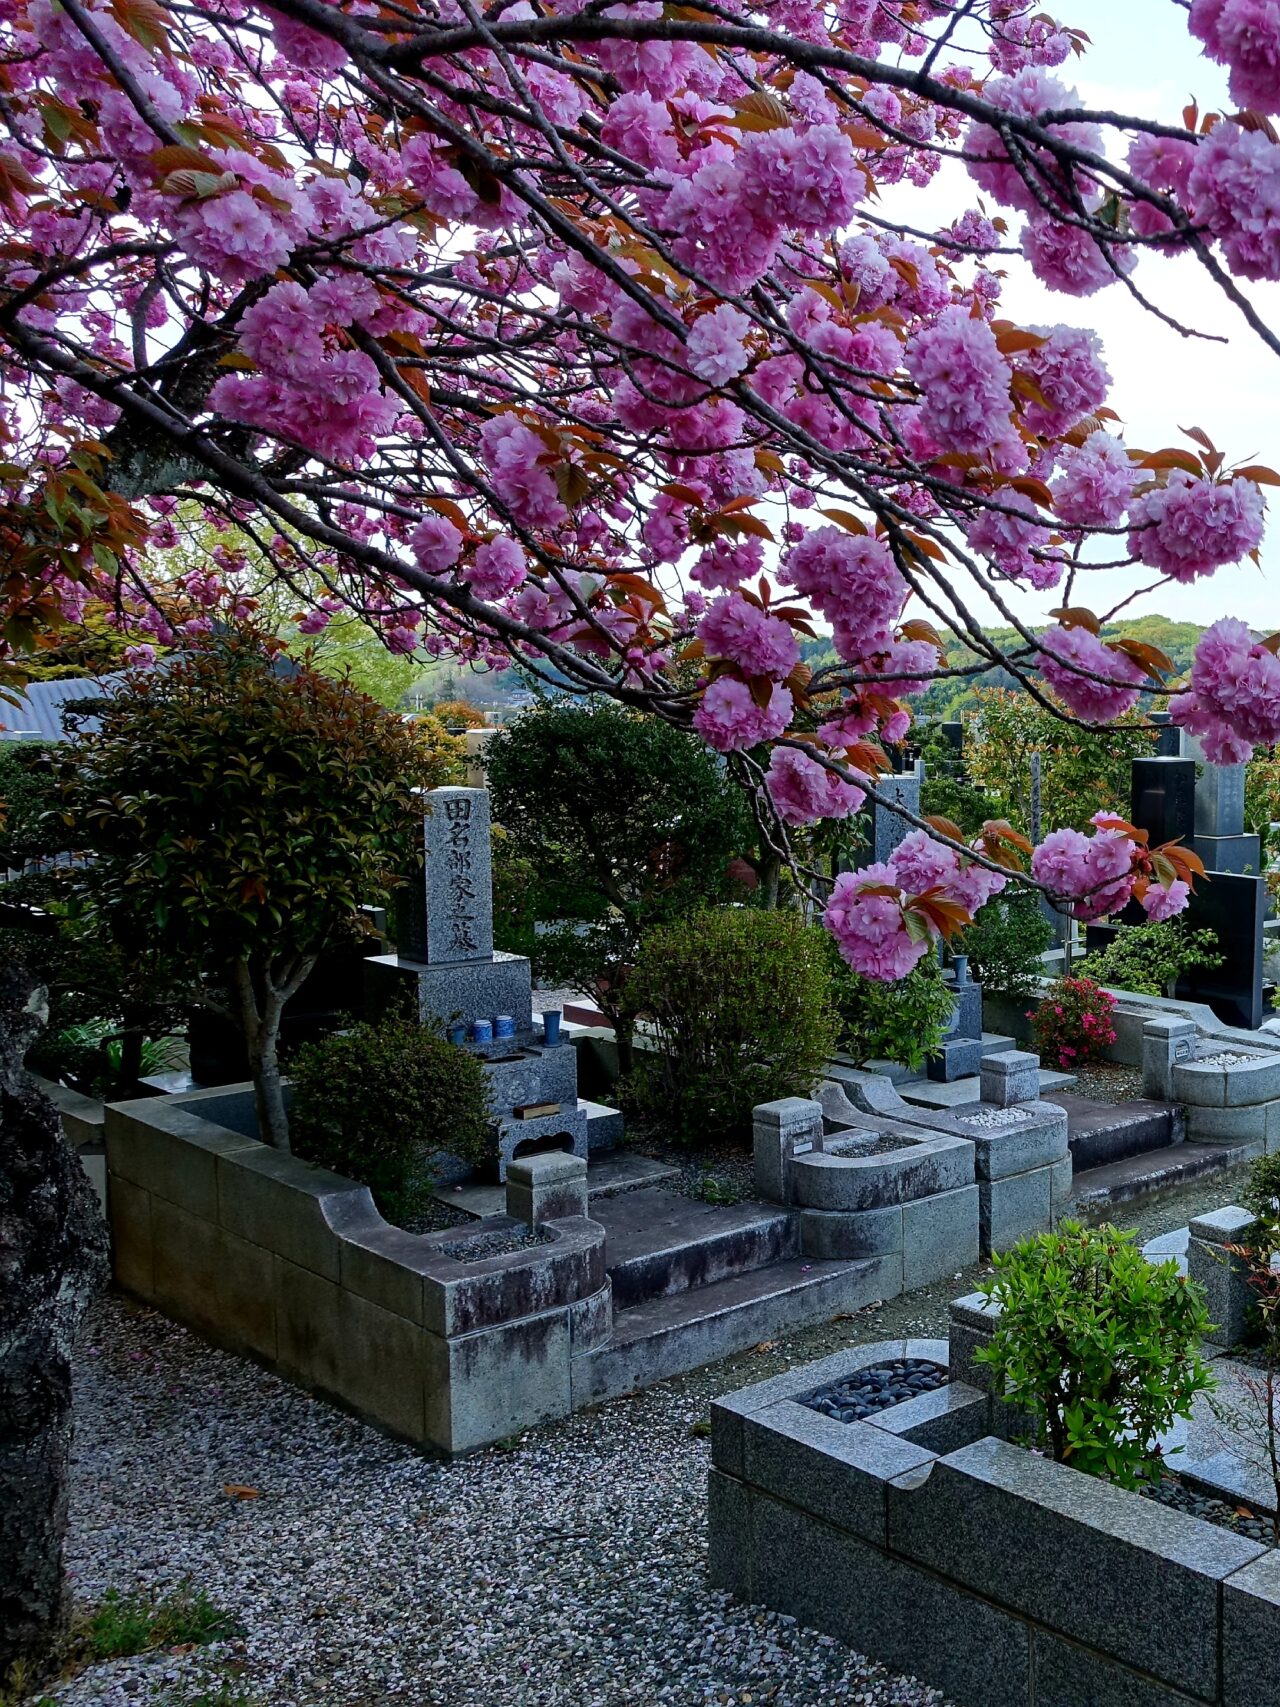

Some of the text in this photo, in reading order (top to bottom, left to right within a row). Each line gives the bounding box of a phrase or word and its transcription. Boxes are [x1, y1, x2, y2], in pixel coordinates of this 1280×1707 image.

[443, 798, 479, 952] 田名部家之墓
